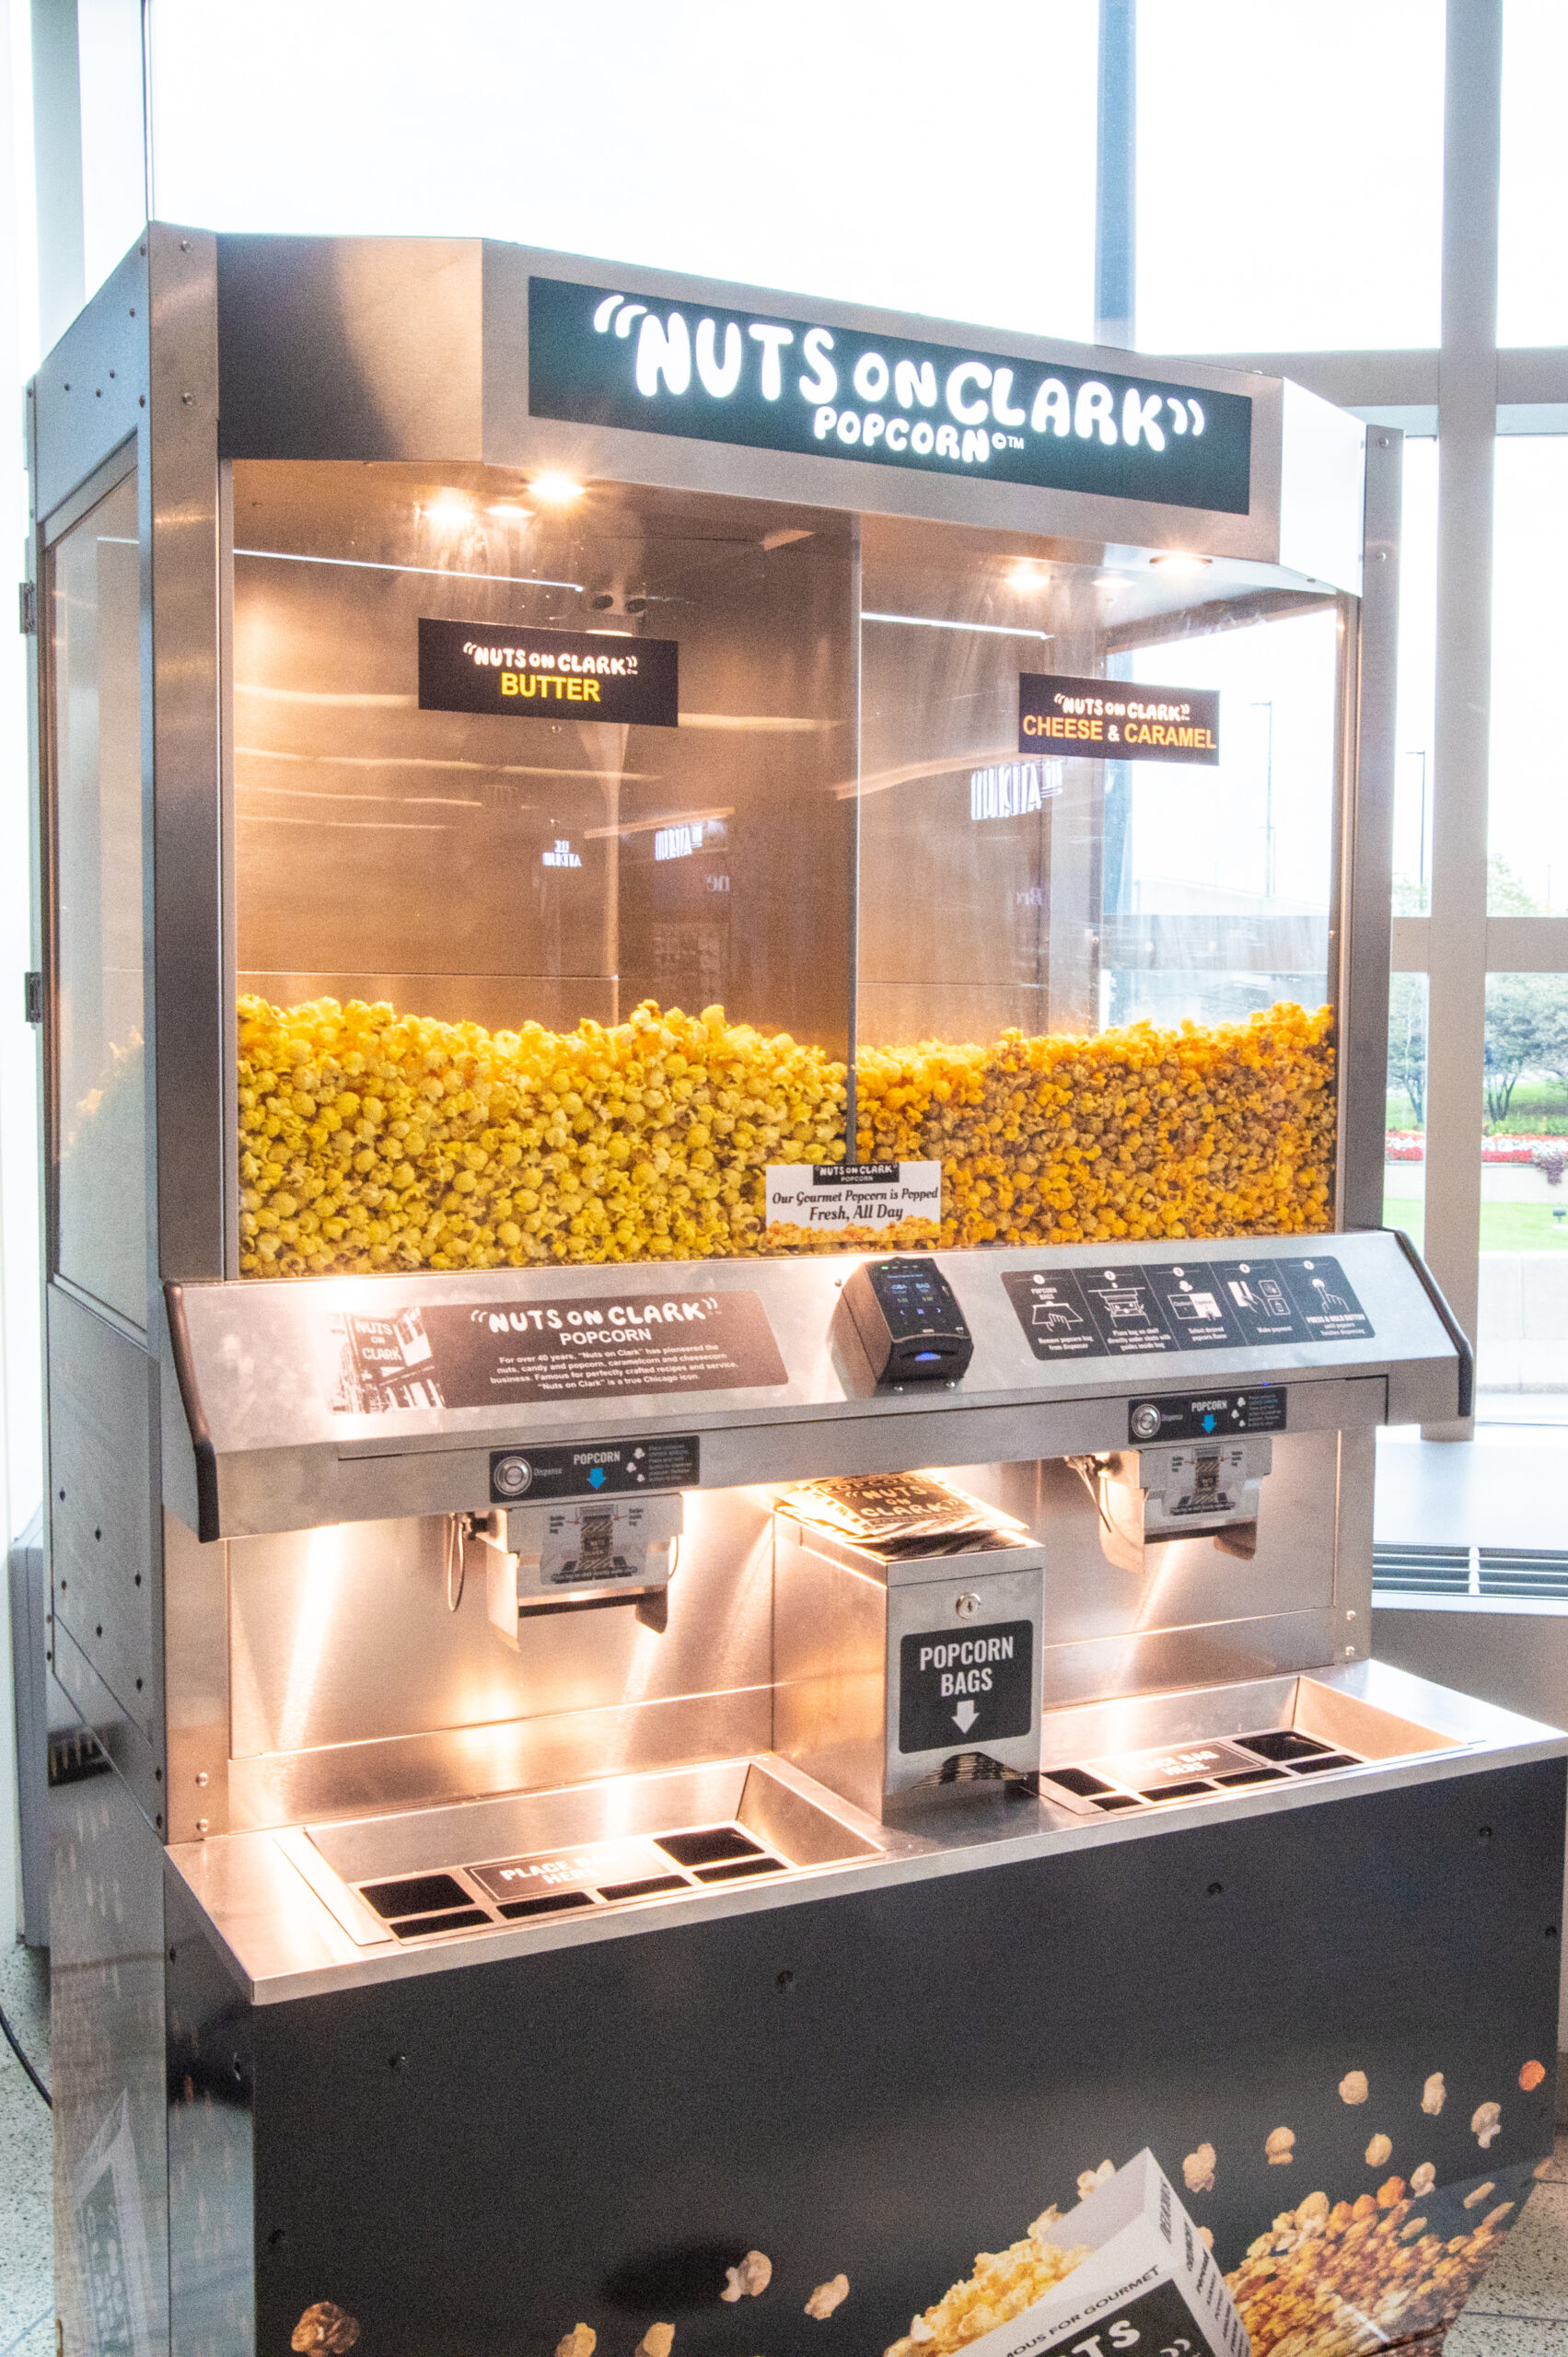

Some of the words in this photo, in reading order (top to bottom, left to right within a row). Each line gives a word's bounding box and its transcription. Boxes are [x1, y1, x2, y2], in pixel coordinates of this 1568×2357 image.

[854, 351, 936, 408] ON
[528, 653, 554, 668] ON
[501, 672, 601, 702] BUTTER
[1105, 702, 1125, 715] ON
[1022, 714, 1103, 740] CHEESE
[1108, 725, 1120, 742] &
[1124, 723, 1217, 749] CARAMEL
[845, 1167, 858, 1175] ON
[772, 1192, 794, 1204] Our
[796, 1191, 842, 1206] Gourmet
[844, 1190, 887, 1203] Popcorn
[889, 1189, 899, 1200] is
[900, 1187, 939, 1202] Popped
[809, 1206, 850, 1222] Fresh,
[854, 1204, 873, 1219] All
[877, 1203, 903, 1221] Day
[566, 1310, 604, 1326] ON
[354, 1321, 393, 1335] NUTS
[370, 1336, 386, 1344] ON
[559, 1328, 652, 1345] POPCORN
[362, 1346, 402, 1361] CLARK
[663, 1344, 704, 1355] pioneered
[521, 1364, 548, 1374] candy
[535, 1373, 570, 1381] Famous
[586, 1369, 623, 1378] perfectly
[625, 1366, 656, 1375] crafted
[656, 1364, 687, 1374] recipes
[644, 1375, 679, 1384] Chicago
[1191, 1399, 1227, 1411] POPCORN
[574, 1451, 621, 1465] POPCORN
[885, 1497, 912, 1505] ON
[920, 1636, 1014, 1671] POPCORN
[940, 1668, 993, 1698] BAGS
[500, 1860, 573, 1880] PLACE
[1050, 2314, 1082, 2336] FOR
[1084, 2264, 1160, 2315] GOURMET
